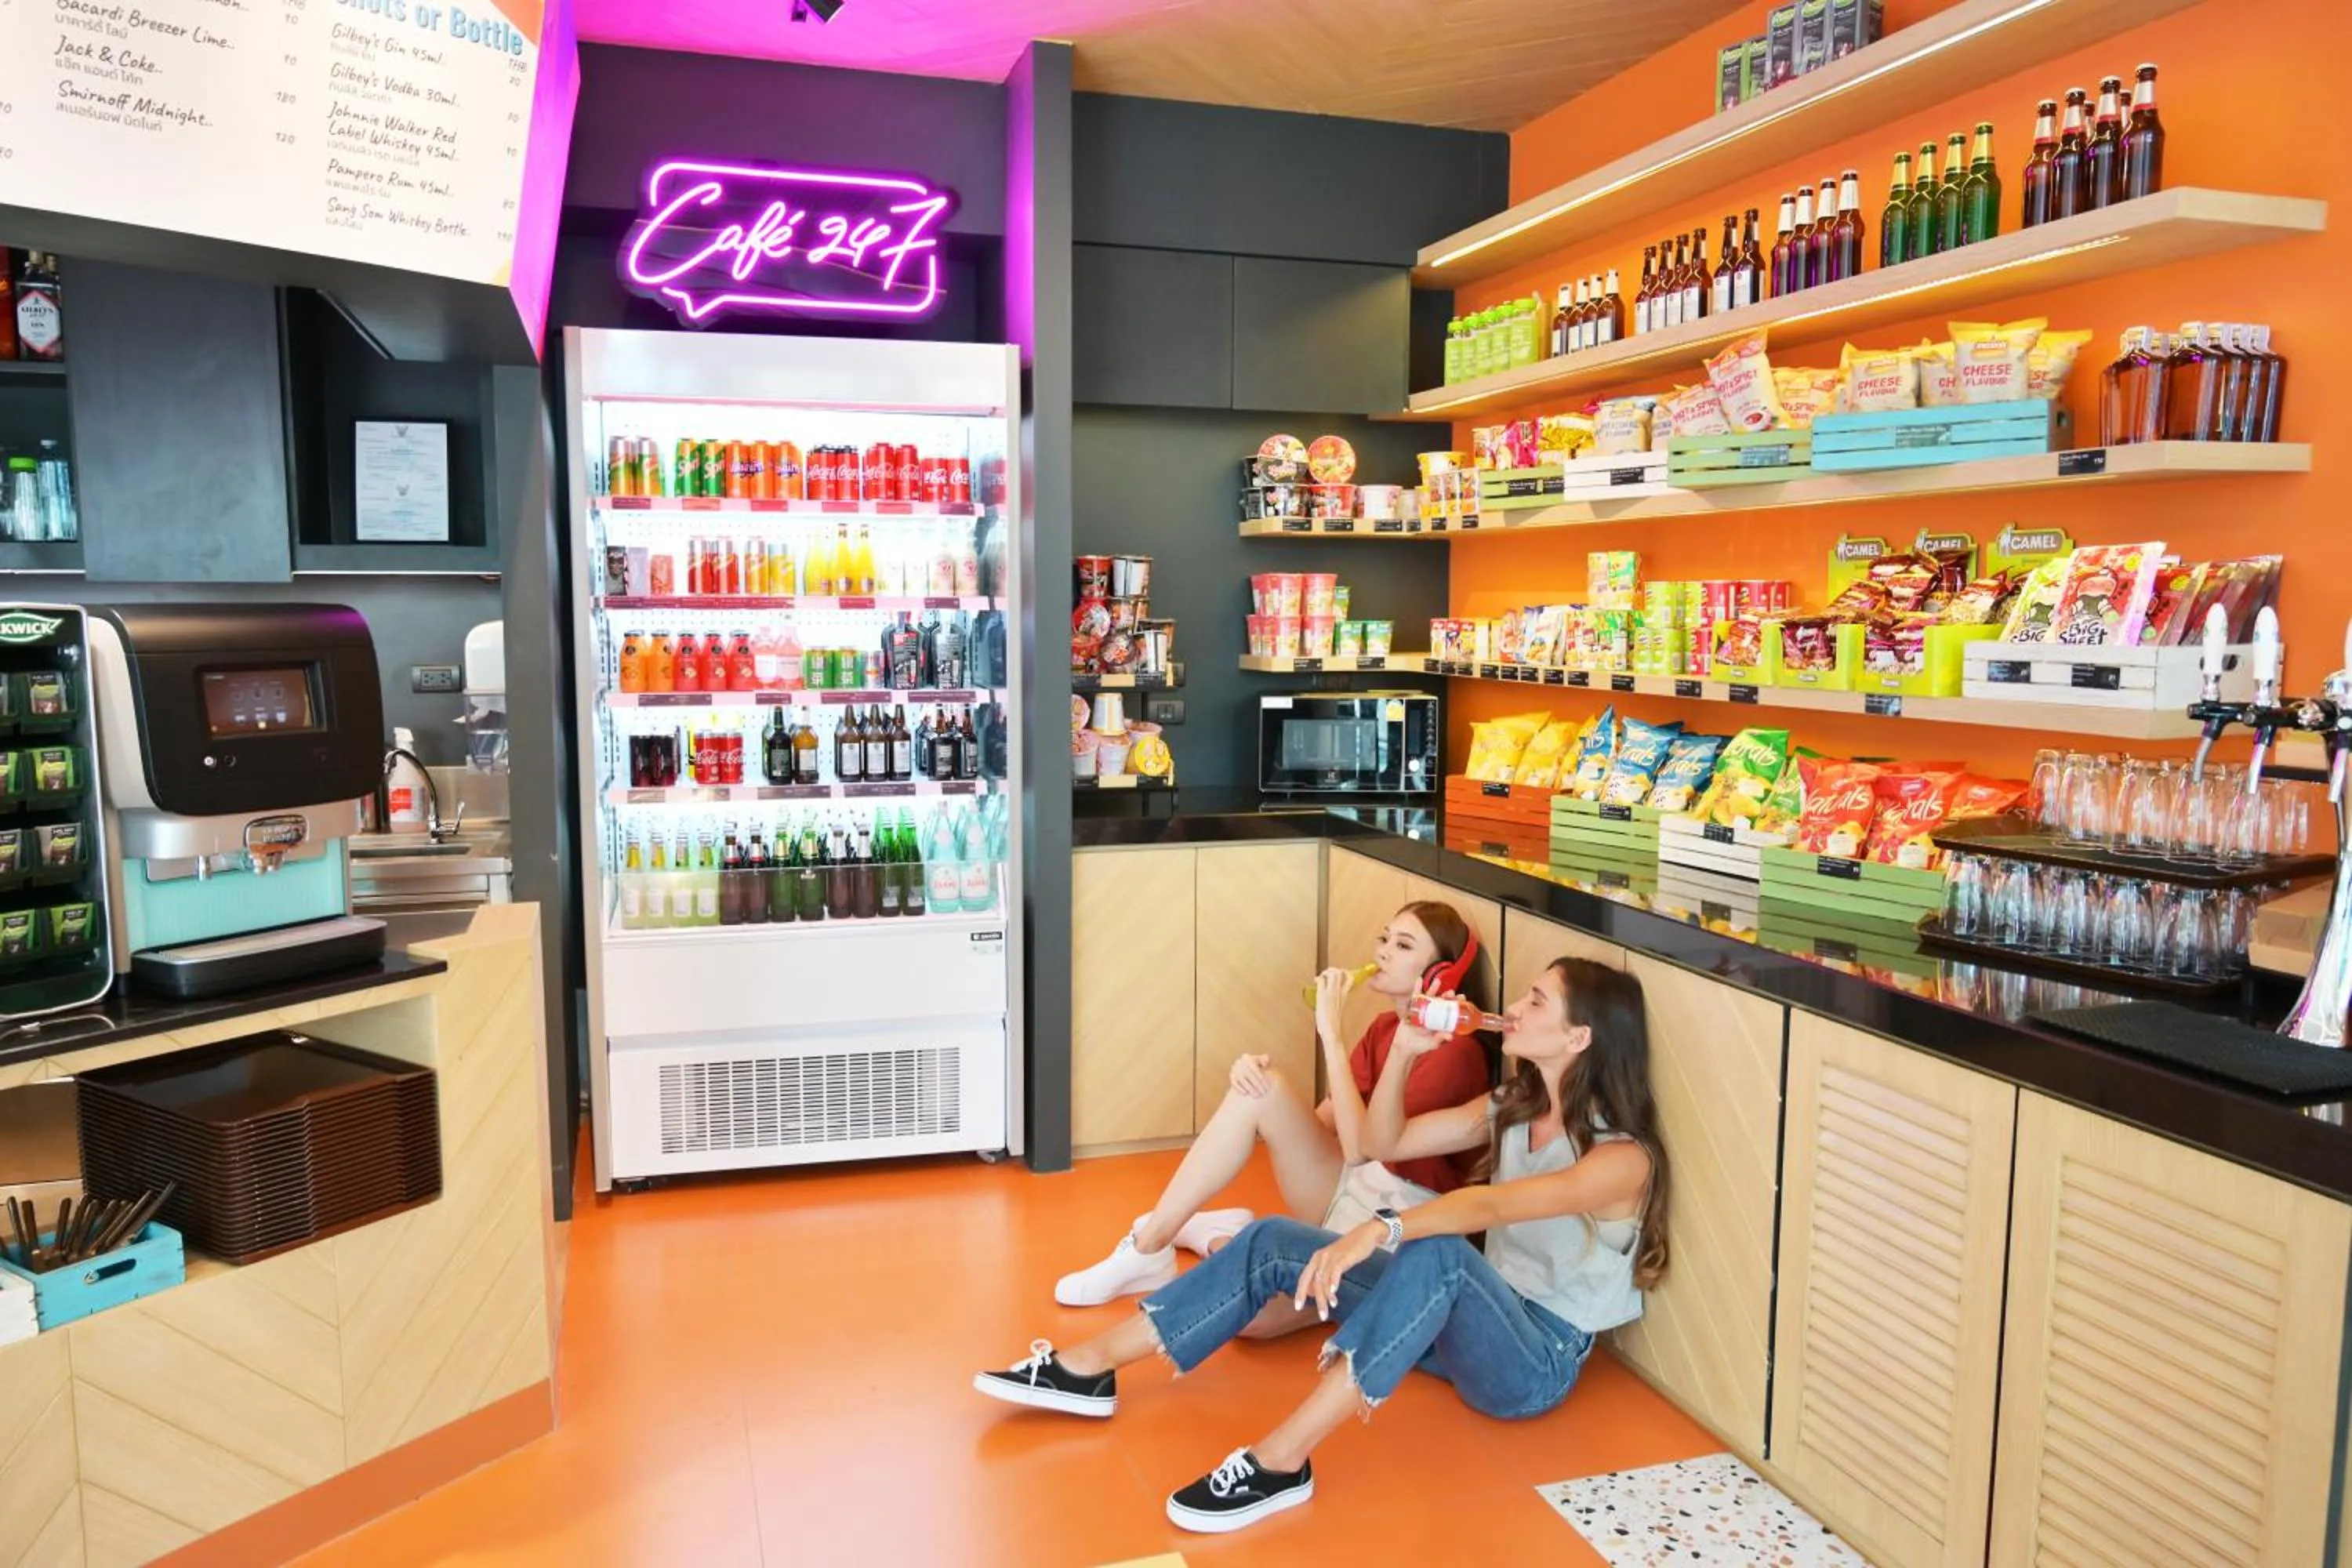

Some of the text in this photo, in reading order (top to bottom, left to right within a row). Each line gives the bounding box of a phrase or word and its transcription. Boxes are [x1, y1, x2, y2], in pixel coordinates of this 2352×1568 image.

[128, 9, 187, 36] Breezer
[415, 4, 442, 31] or
[450, 5, 524, 56] Bottle
[54, 34, 93, 58] Jack
[99, 46, 114, 64] &
[332, 23, 379, 49] Gilbey's
[384, 37, 405, 54] Gin
[330, 62, 378, 87] Gilbey's
[385, 76, 420, 97] Vodka
[59, 80, 131, 110] Smirnoff
[327, 101, 457, 143] Johnnie Walker Red
[328, 120, 365, 140] Label
[370, 130, 421, 156] Whiskey
[327, 158, 383, 183] Pampero
[388, 171, 414, 189] Rum
[328, 197, 357, 219] Sang
[361, 203, 384, 220] Som
[389, 209, 432, 233] Whiskey
[630, 183, 805, 281] Café
[1857, 376, 1903, 390] CHEESE
[1963, 363, 2013, 377] CHEESE
[1965, 377, 2009, 387] FLAVOUR
[1859, 387, 1898, 398] FLAVOUR
[1845, 543, 1879, 557] CAMEL
[2011, 534, 2056, 549] CAMEL
[0, 622, 55, 634] KWICK
[2018, 630, 2046, 642] BIG
[2069, 622, 2100, 637] BIG
